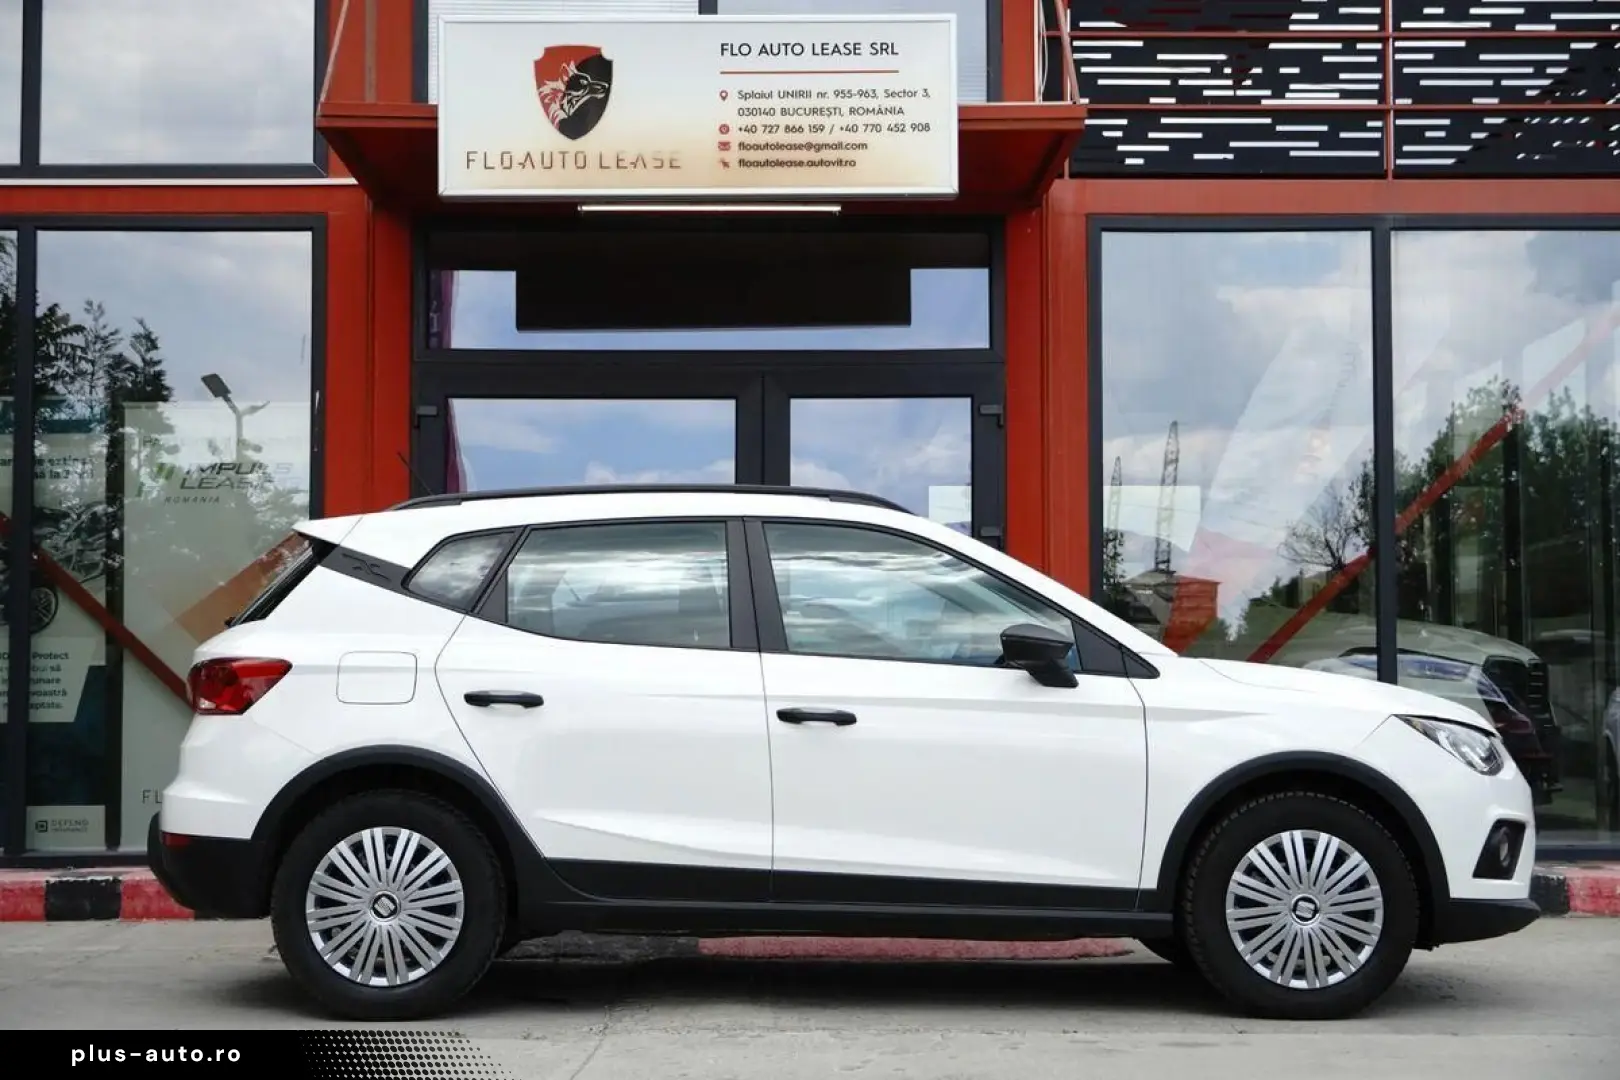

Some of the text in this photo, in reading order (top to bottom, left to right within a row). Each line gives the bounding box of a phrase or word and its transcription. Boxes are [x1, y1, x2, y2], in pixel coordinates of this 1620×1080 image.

[720, 42, 899, 57] FLO AUTO LEASE SRL
[737, 88, 931, 101] Splaiul UNIRII nr. 955-963, Sector 3,
[737, 107, 776, 117] 030140
[849, 104, 905, 116] ROMÂNIA
[737, 124, 758, 134] +40
[762, 124, 780, 134] 727
[784, 124, 804, 134] 866
[808, 123, 826, 134] 159
[839, 123, 858, 134] +40
[863, 123, 882, 133] 770
[886, 123, 907, 133] 452
[910, 122, 931, 133] 908
[738, 141, 868, 152] floautolease@gmail.com
[599, 151, 682, 170] LEASE
[738, 158, 857, 168] floautolease.autovit.ro
